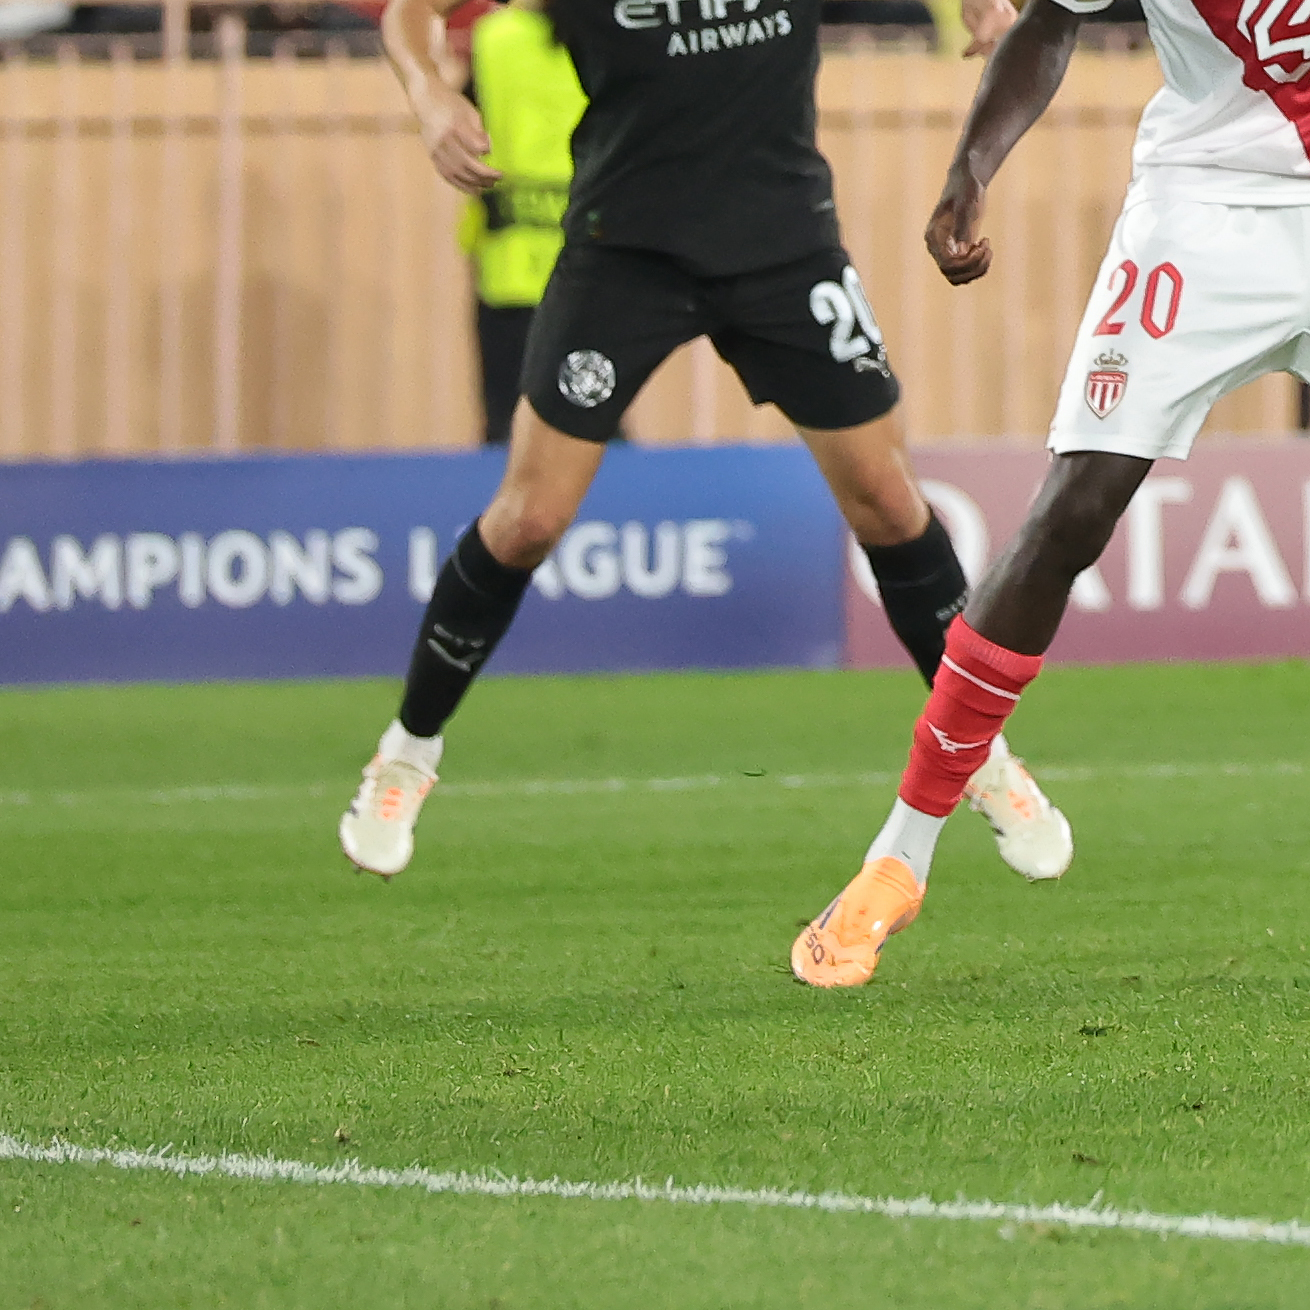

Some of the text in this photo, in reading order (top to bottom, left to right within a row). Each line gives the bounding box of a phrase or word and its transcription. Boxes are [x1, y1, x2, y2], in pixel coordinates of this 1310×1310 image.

[666, 9, 794, 58] AIRWAYS
[1091, 258, 1185, 340] 20
[0, 519, 735, 614] AMPIONS LGUE
